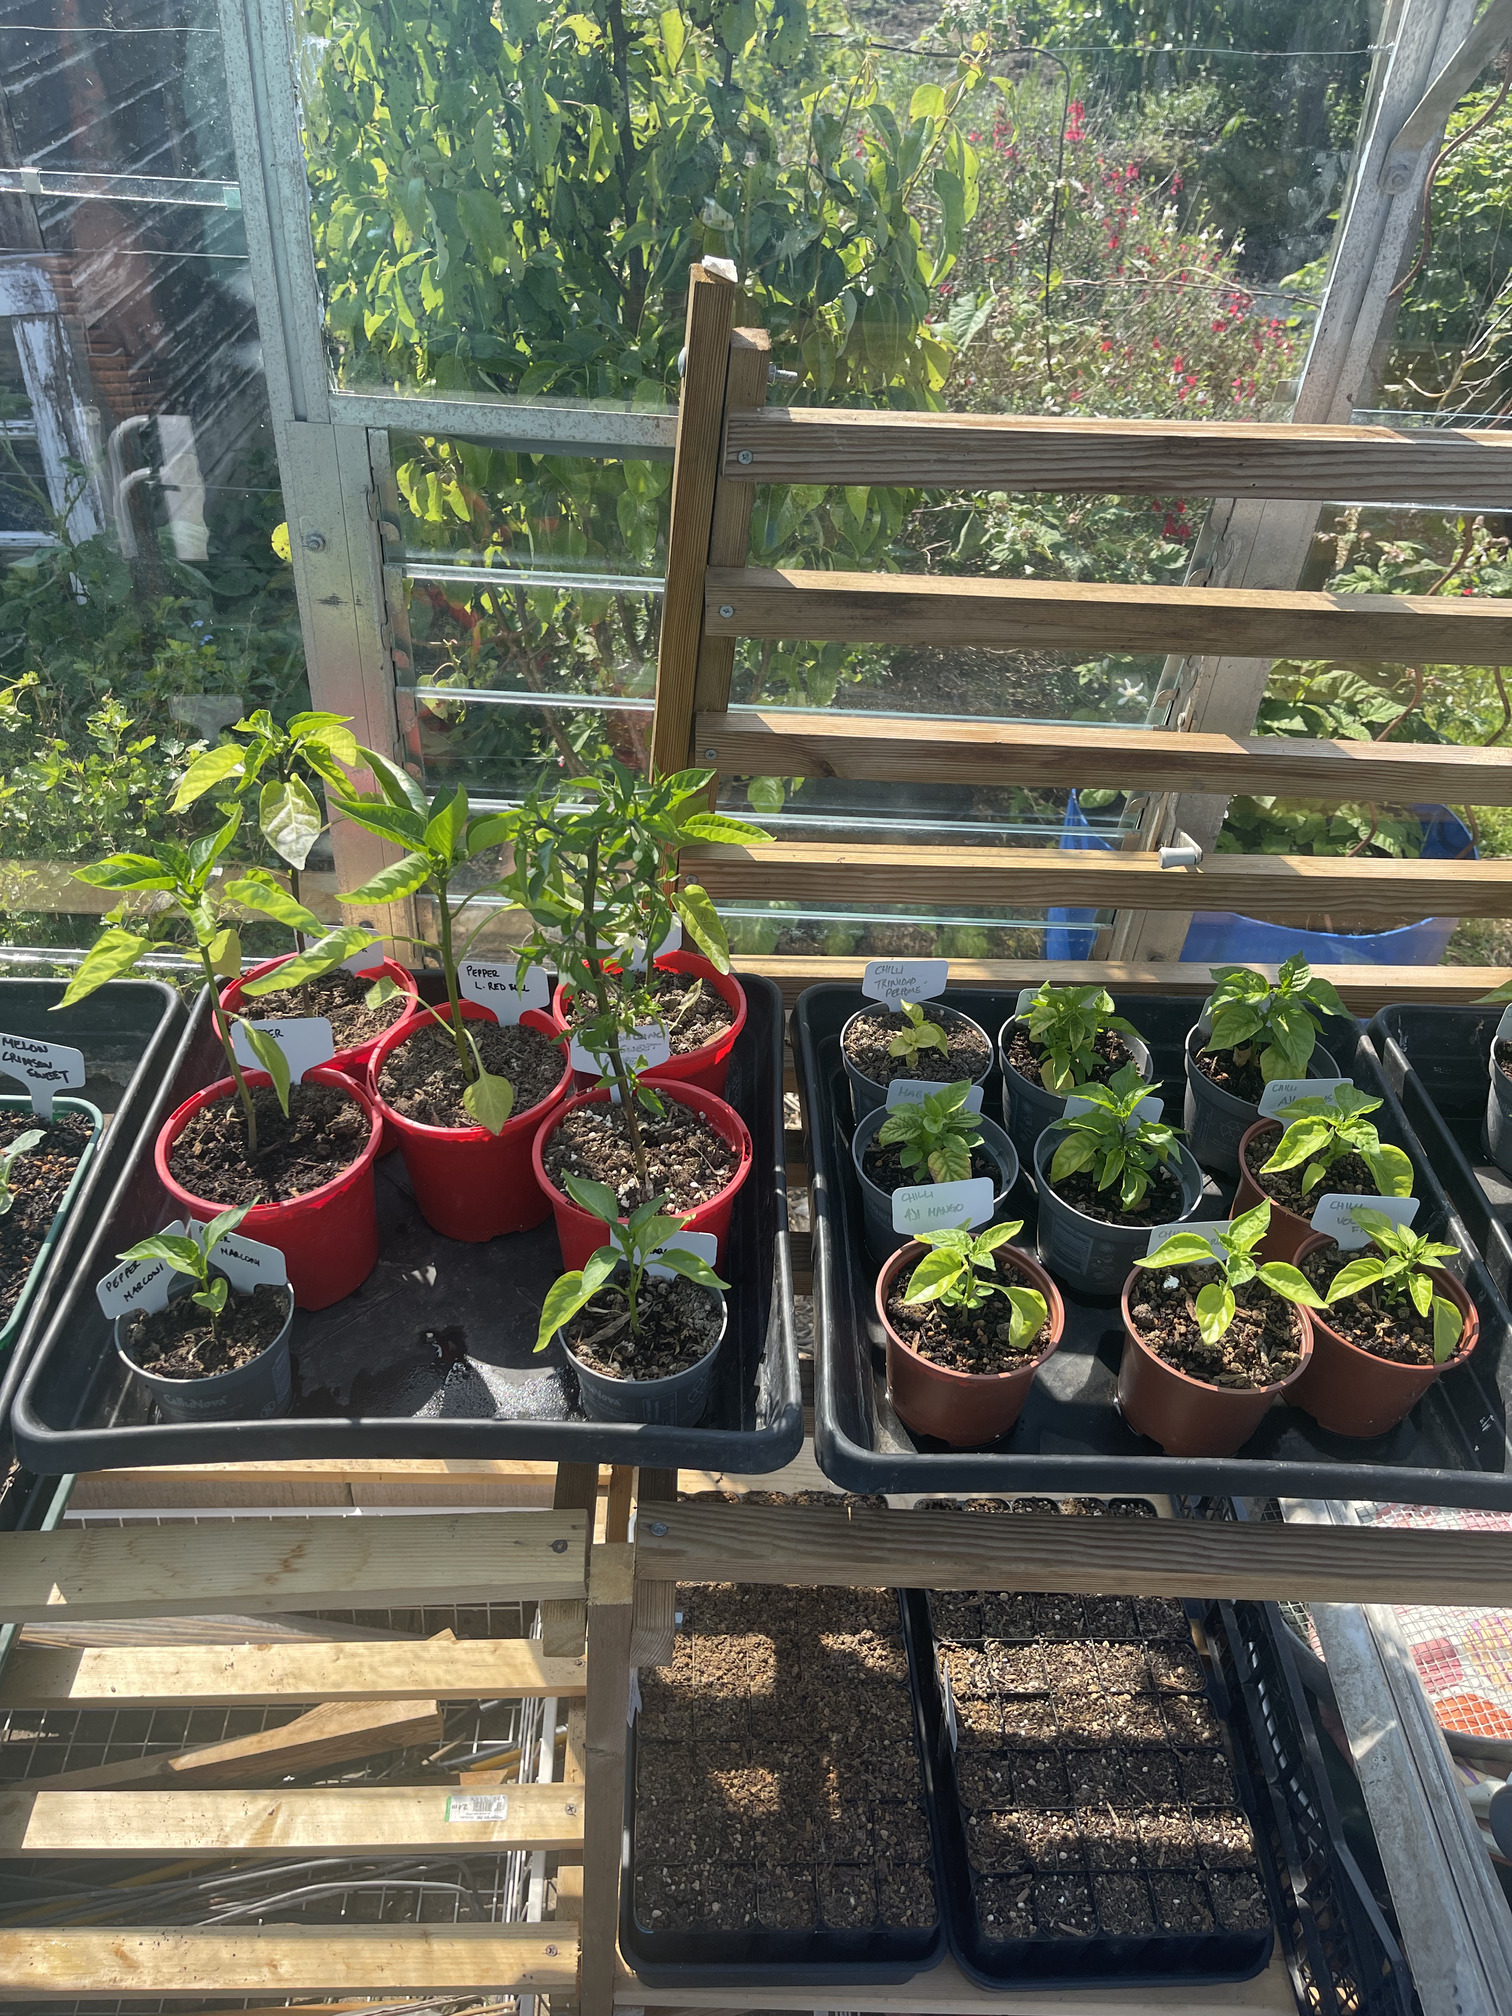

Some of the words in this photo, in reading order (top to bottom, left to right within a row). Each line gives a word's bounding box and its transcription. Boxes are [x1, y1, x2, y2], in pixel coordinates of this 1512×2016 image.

[466, 965, 500, 978] PEPPER
[875, 965, 904, 975] CHILLI
[487, 982, 507, 991] RED
[874, 977, 916, 990] TRINIDAD
[2, 1036, 48, 1053] MELON
[26, 1068, 70, 1083] SWEET
[901, 1189, 935, 1203] CHILLI
[903, 1207, 921, 1222] AJI
[927, 1203, 964, 1218] MANGO
[105, 1260, 142, 1292] PEPPER
[123, 1262, 165, 1302] MARCONI
